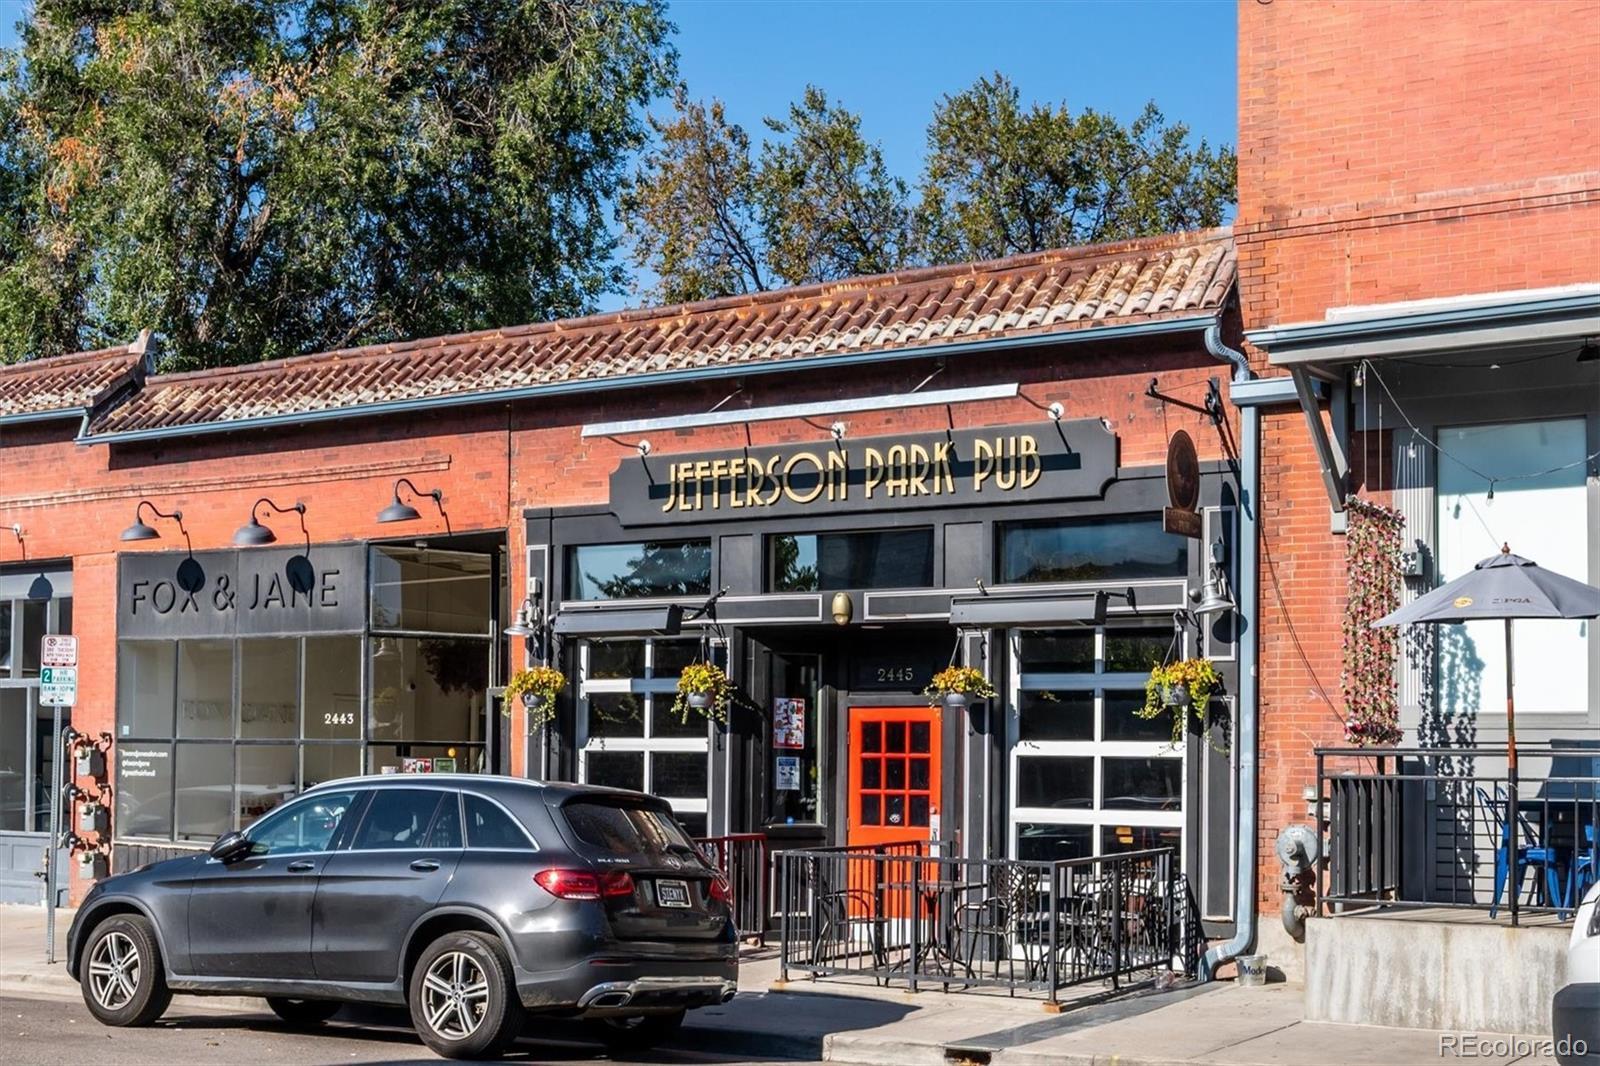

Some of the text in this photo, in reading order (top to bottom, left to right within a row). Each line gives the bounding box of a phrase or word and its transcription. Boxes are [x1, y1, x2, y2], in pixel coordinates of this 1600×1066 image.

[662, 435, 1041, 512] JEFFERSON PARK PUB
[131, 569, 340, 615] FOX & JANE
[43, 669, 50, 682] 2
[877, 667, 914, 682] 2445
[324, 712, 354, 725] 2443
